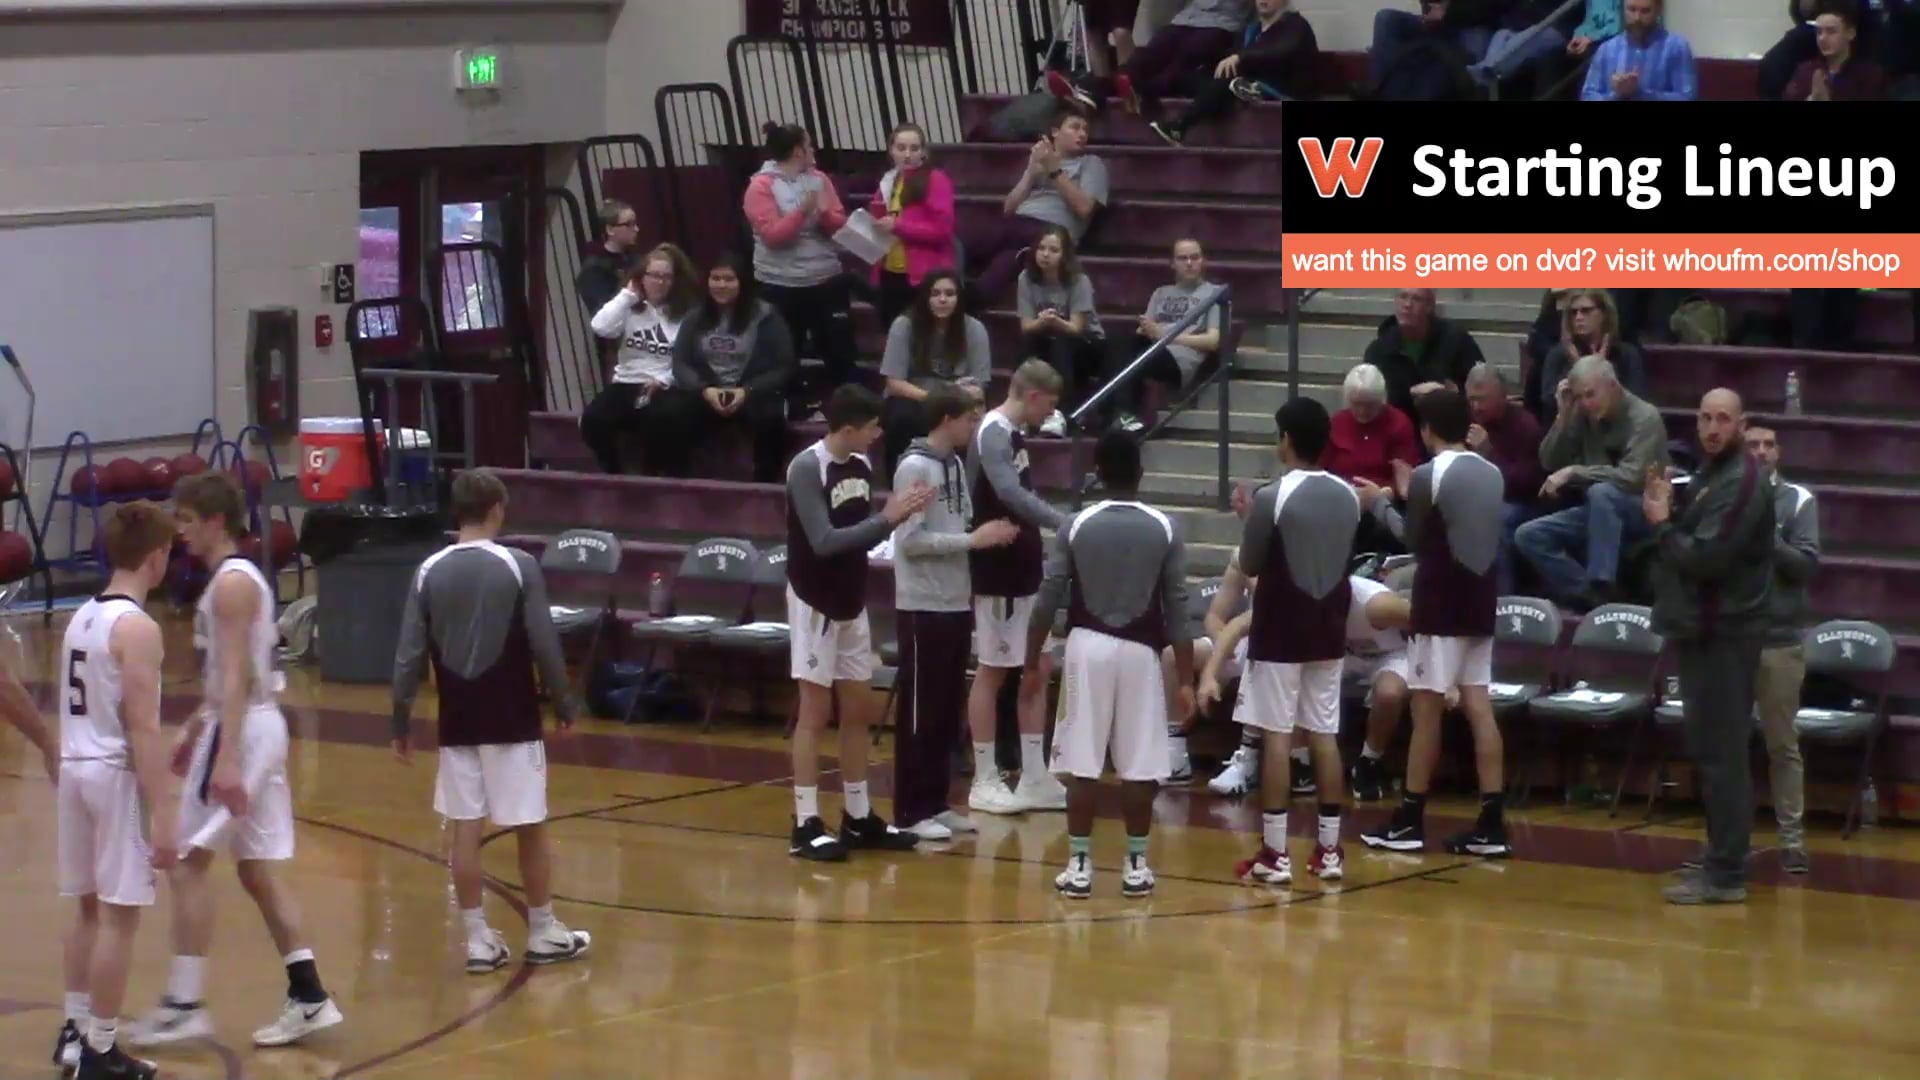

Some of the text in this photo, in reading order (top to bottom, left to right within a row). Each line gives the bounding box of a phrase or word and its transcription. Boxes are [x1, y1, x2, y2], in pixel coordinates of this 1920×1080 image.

[869, 0, 909, 17] WLK
[698, 544, 747, 560] ELLSWORTH
[1495, 604, 1546, 622] LLSWORTH
[1593, 611, 1651, 630] ELLSWORTH
[1816, 629, 1878, 646] ELLSWORTH
[69, 649, 87, 715] 5
